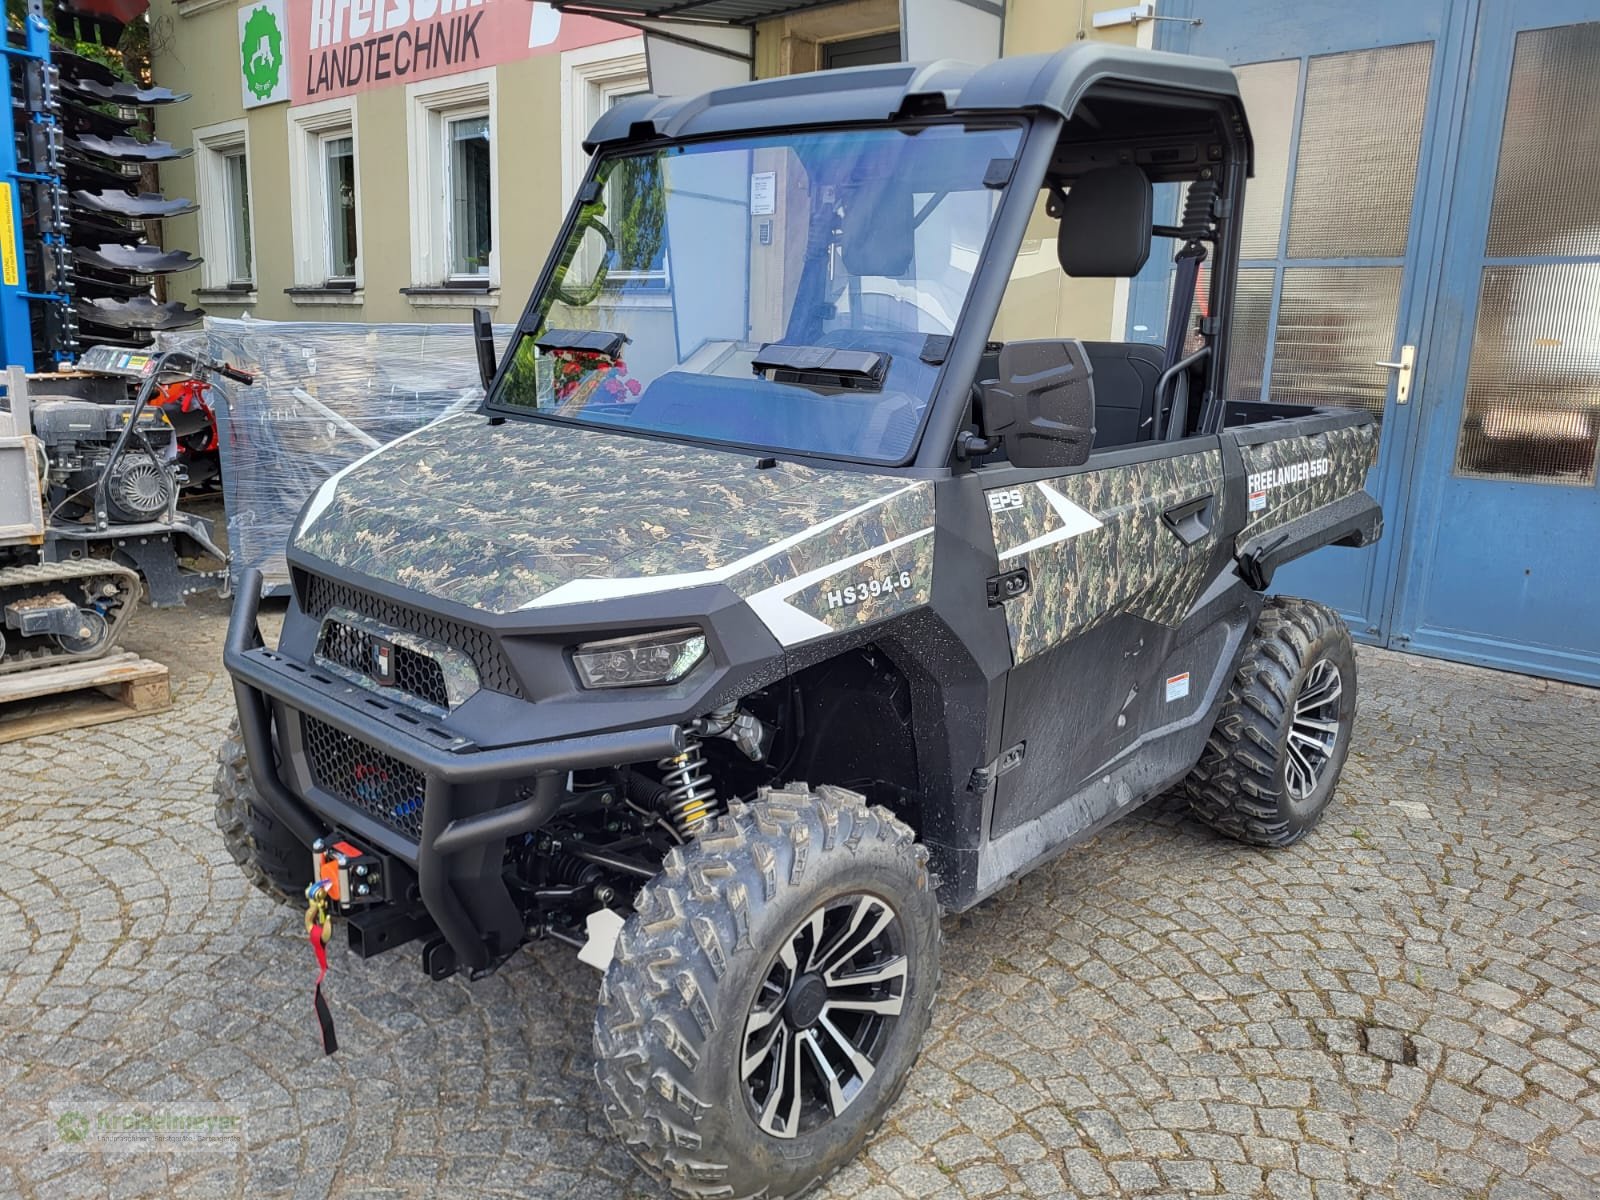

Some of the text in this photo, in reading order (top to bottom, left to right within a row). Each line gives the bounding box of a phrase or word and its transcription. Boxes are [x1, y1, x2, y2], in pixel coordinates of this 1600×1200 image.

[306, 10, 484, 96] LANDTECHNIK
[1248, 458, 1328, 494] FREELANDER 550
[988, 489, 1022, 510] EPS
[827, 571, 911, 609] HS394-6
